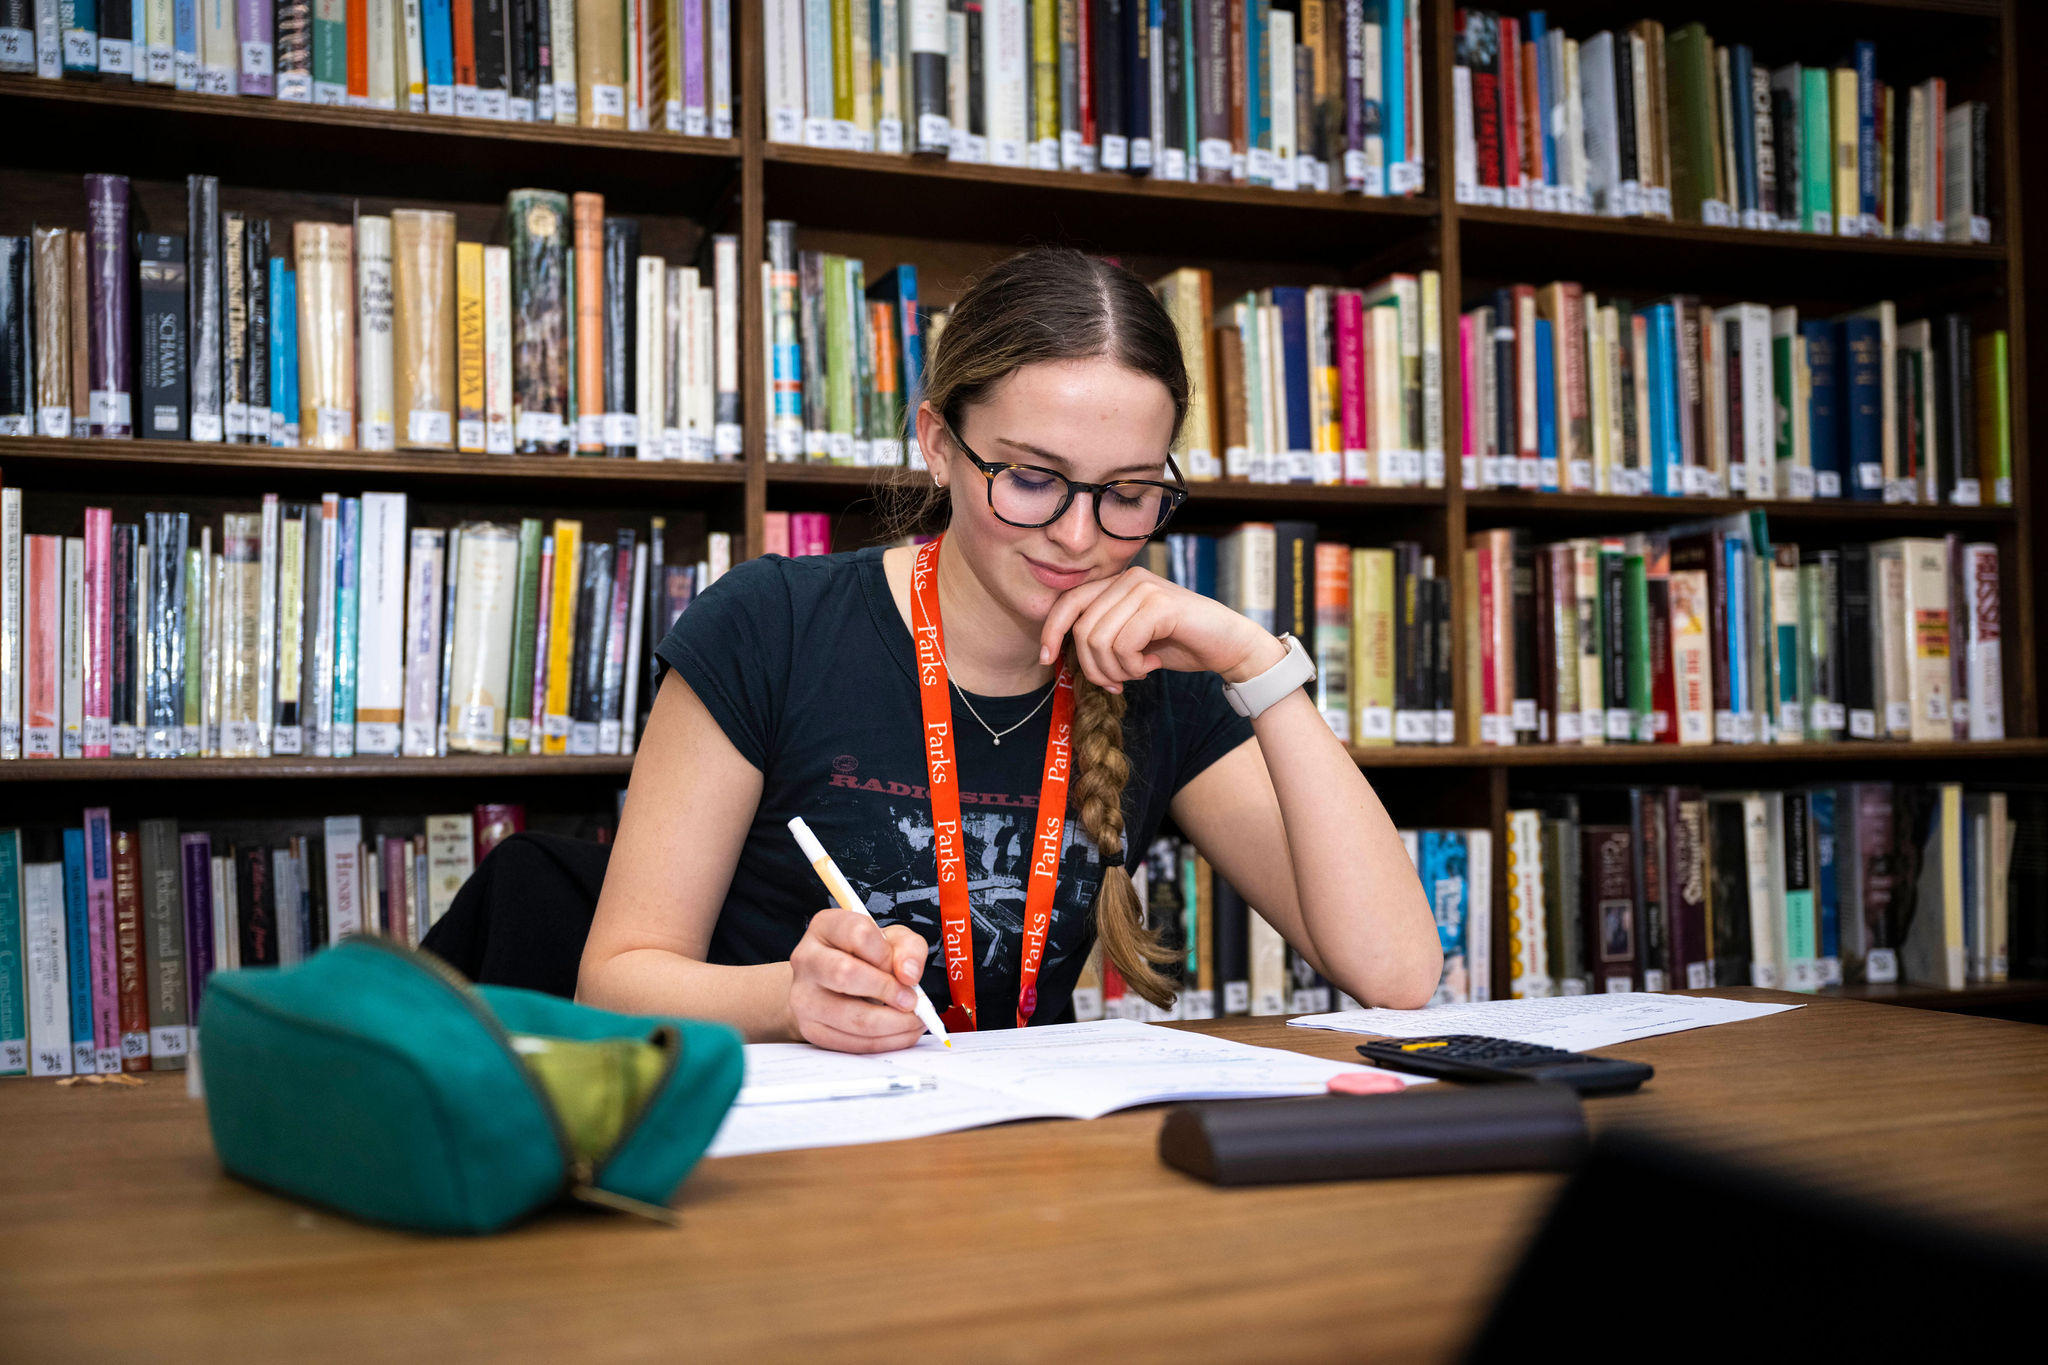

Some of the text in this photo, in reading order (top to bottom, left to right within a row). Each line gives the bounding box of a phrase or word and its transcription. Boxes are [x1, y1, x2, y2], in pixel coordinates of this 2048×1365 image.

[159, 312, 176, 388] SCHAMA
[461, 296, 481, 397] MATILDA
[916, 541, 939, 590] Parks
[1975, 551, 2001, 643] RUSSIA
[917, 624, 941, 686] Parks
[928, 721, 951, 784] Parks
[1048, 723, 1070, 783] Parks
[938, 819, 960, 882] Parks
[1035, 816, 1060, 878] Parks
[336, 851, 354, 915] HENRY
[116, 860, 137, 993] THE TUDORS
[151, 868, 181, 1013] Policy and Police
[946, 917, 968, 981] Parks
[1024, 912, 1047, 974] Parks
